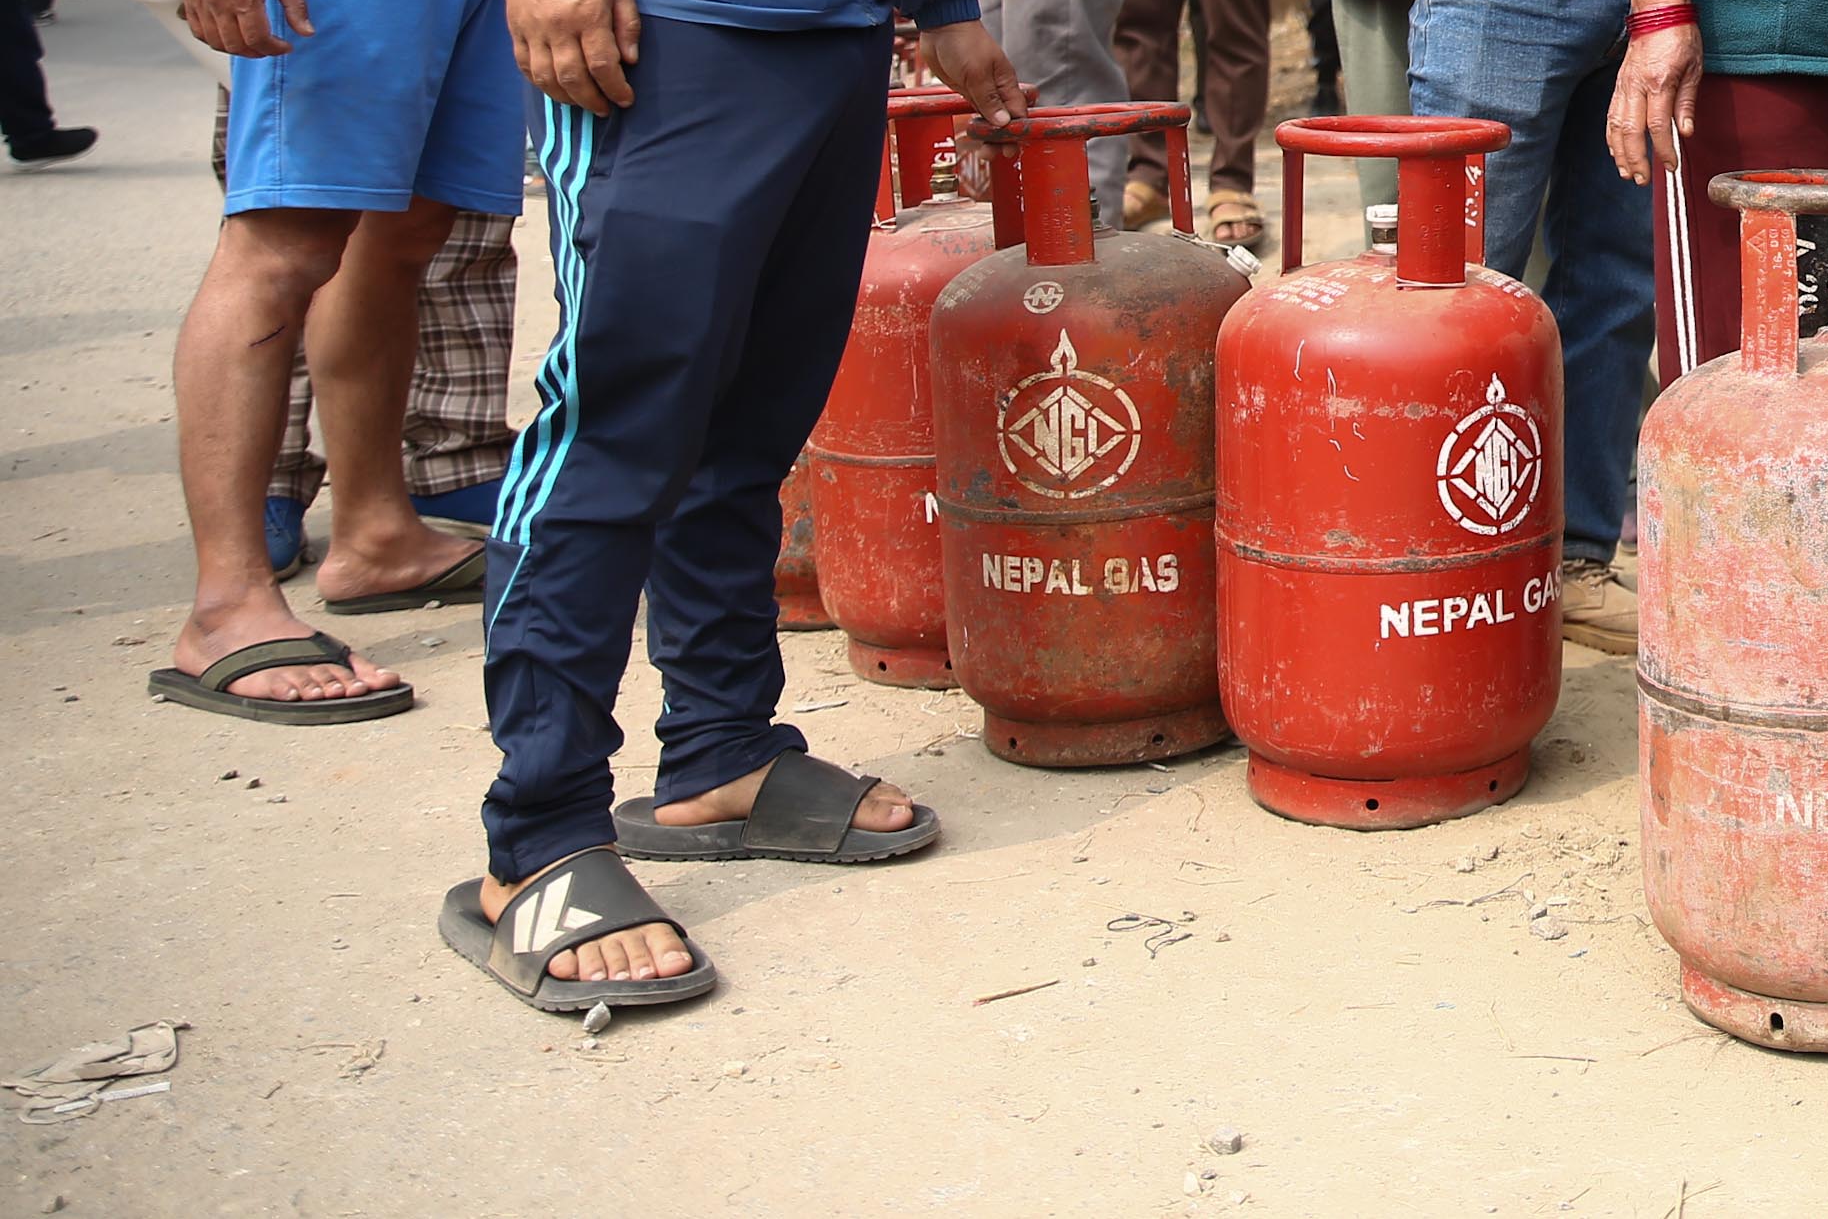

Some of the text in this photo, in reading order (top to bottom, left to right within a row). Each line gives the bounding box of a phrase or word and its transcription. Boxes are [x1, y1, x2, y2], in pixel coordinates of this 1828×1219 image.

[982, 553, 1180, 595] NEPAL GAS
[1380, 589, 1515, 639] NEPAL
